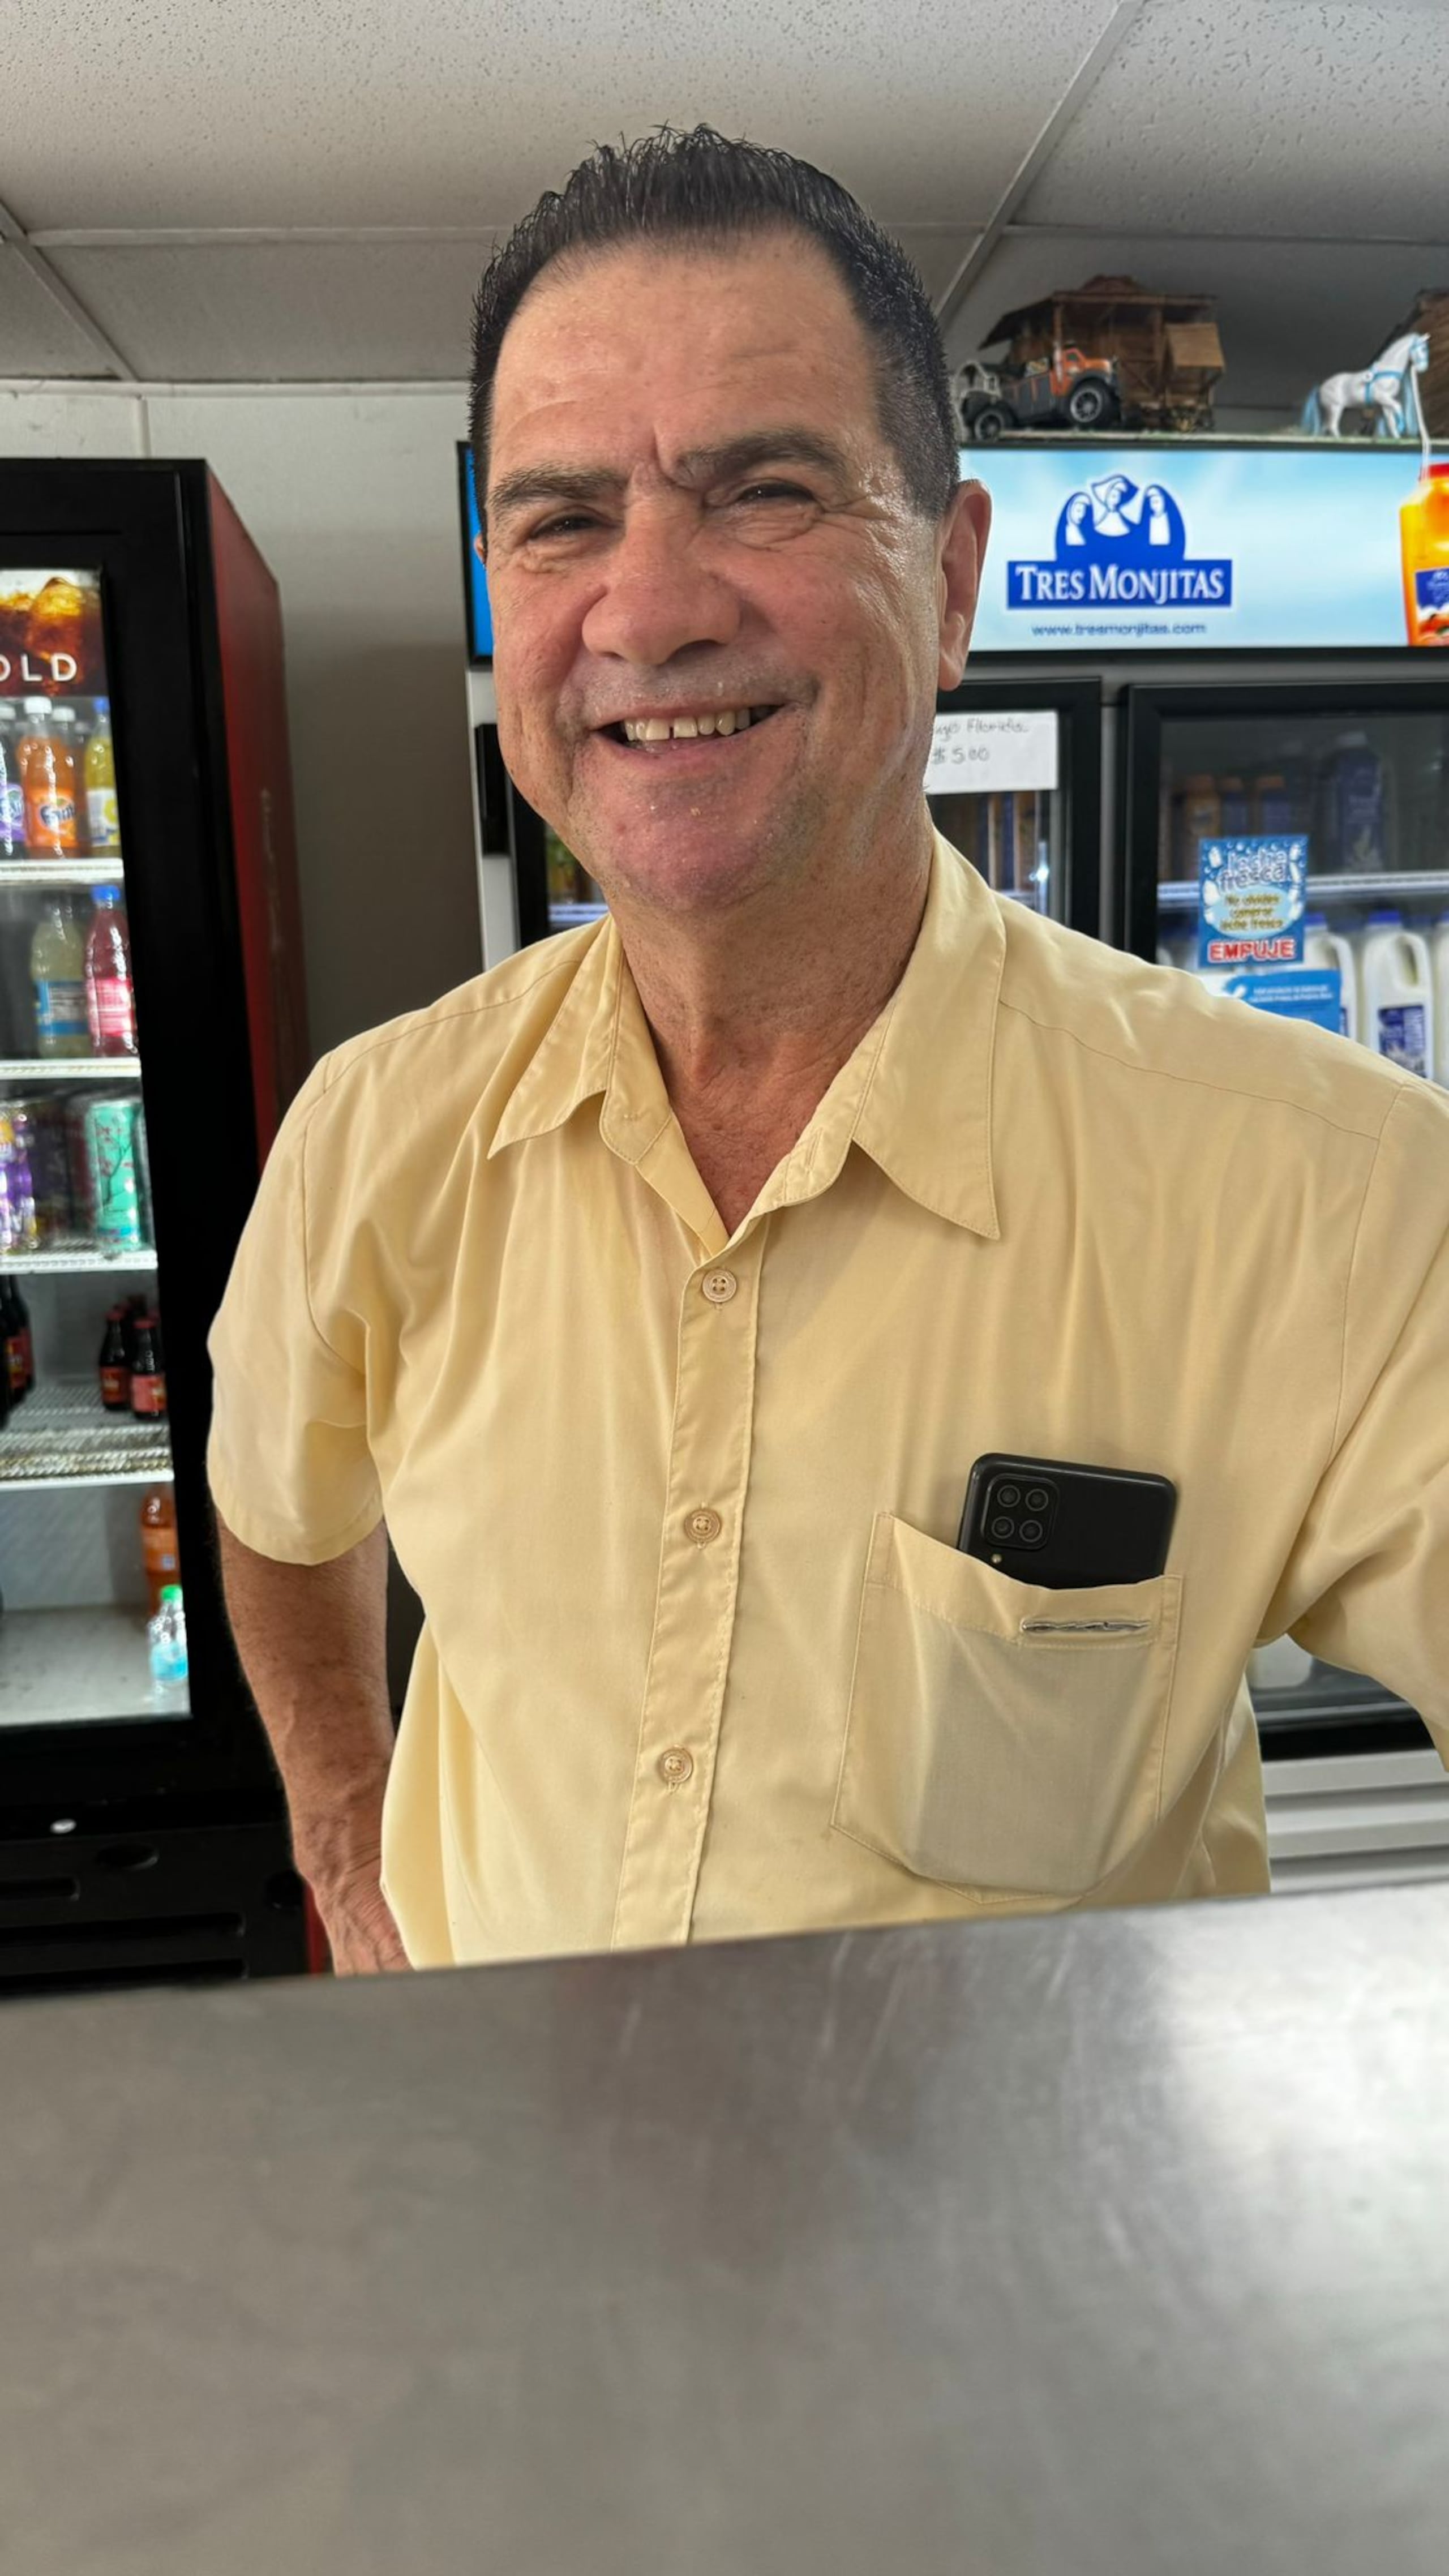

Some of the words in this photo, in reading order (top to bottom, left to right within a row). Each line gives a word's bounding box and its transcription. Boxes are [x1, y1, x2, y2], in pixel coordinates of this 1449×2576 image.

[1015, 564, 1084, 600] TRES
[1089, 564, 1224, 605] MONJITAS
[1209, 939, 1295, 962] EMPUJE
